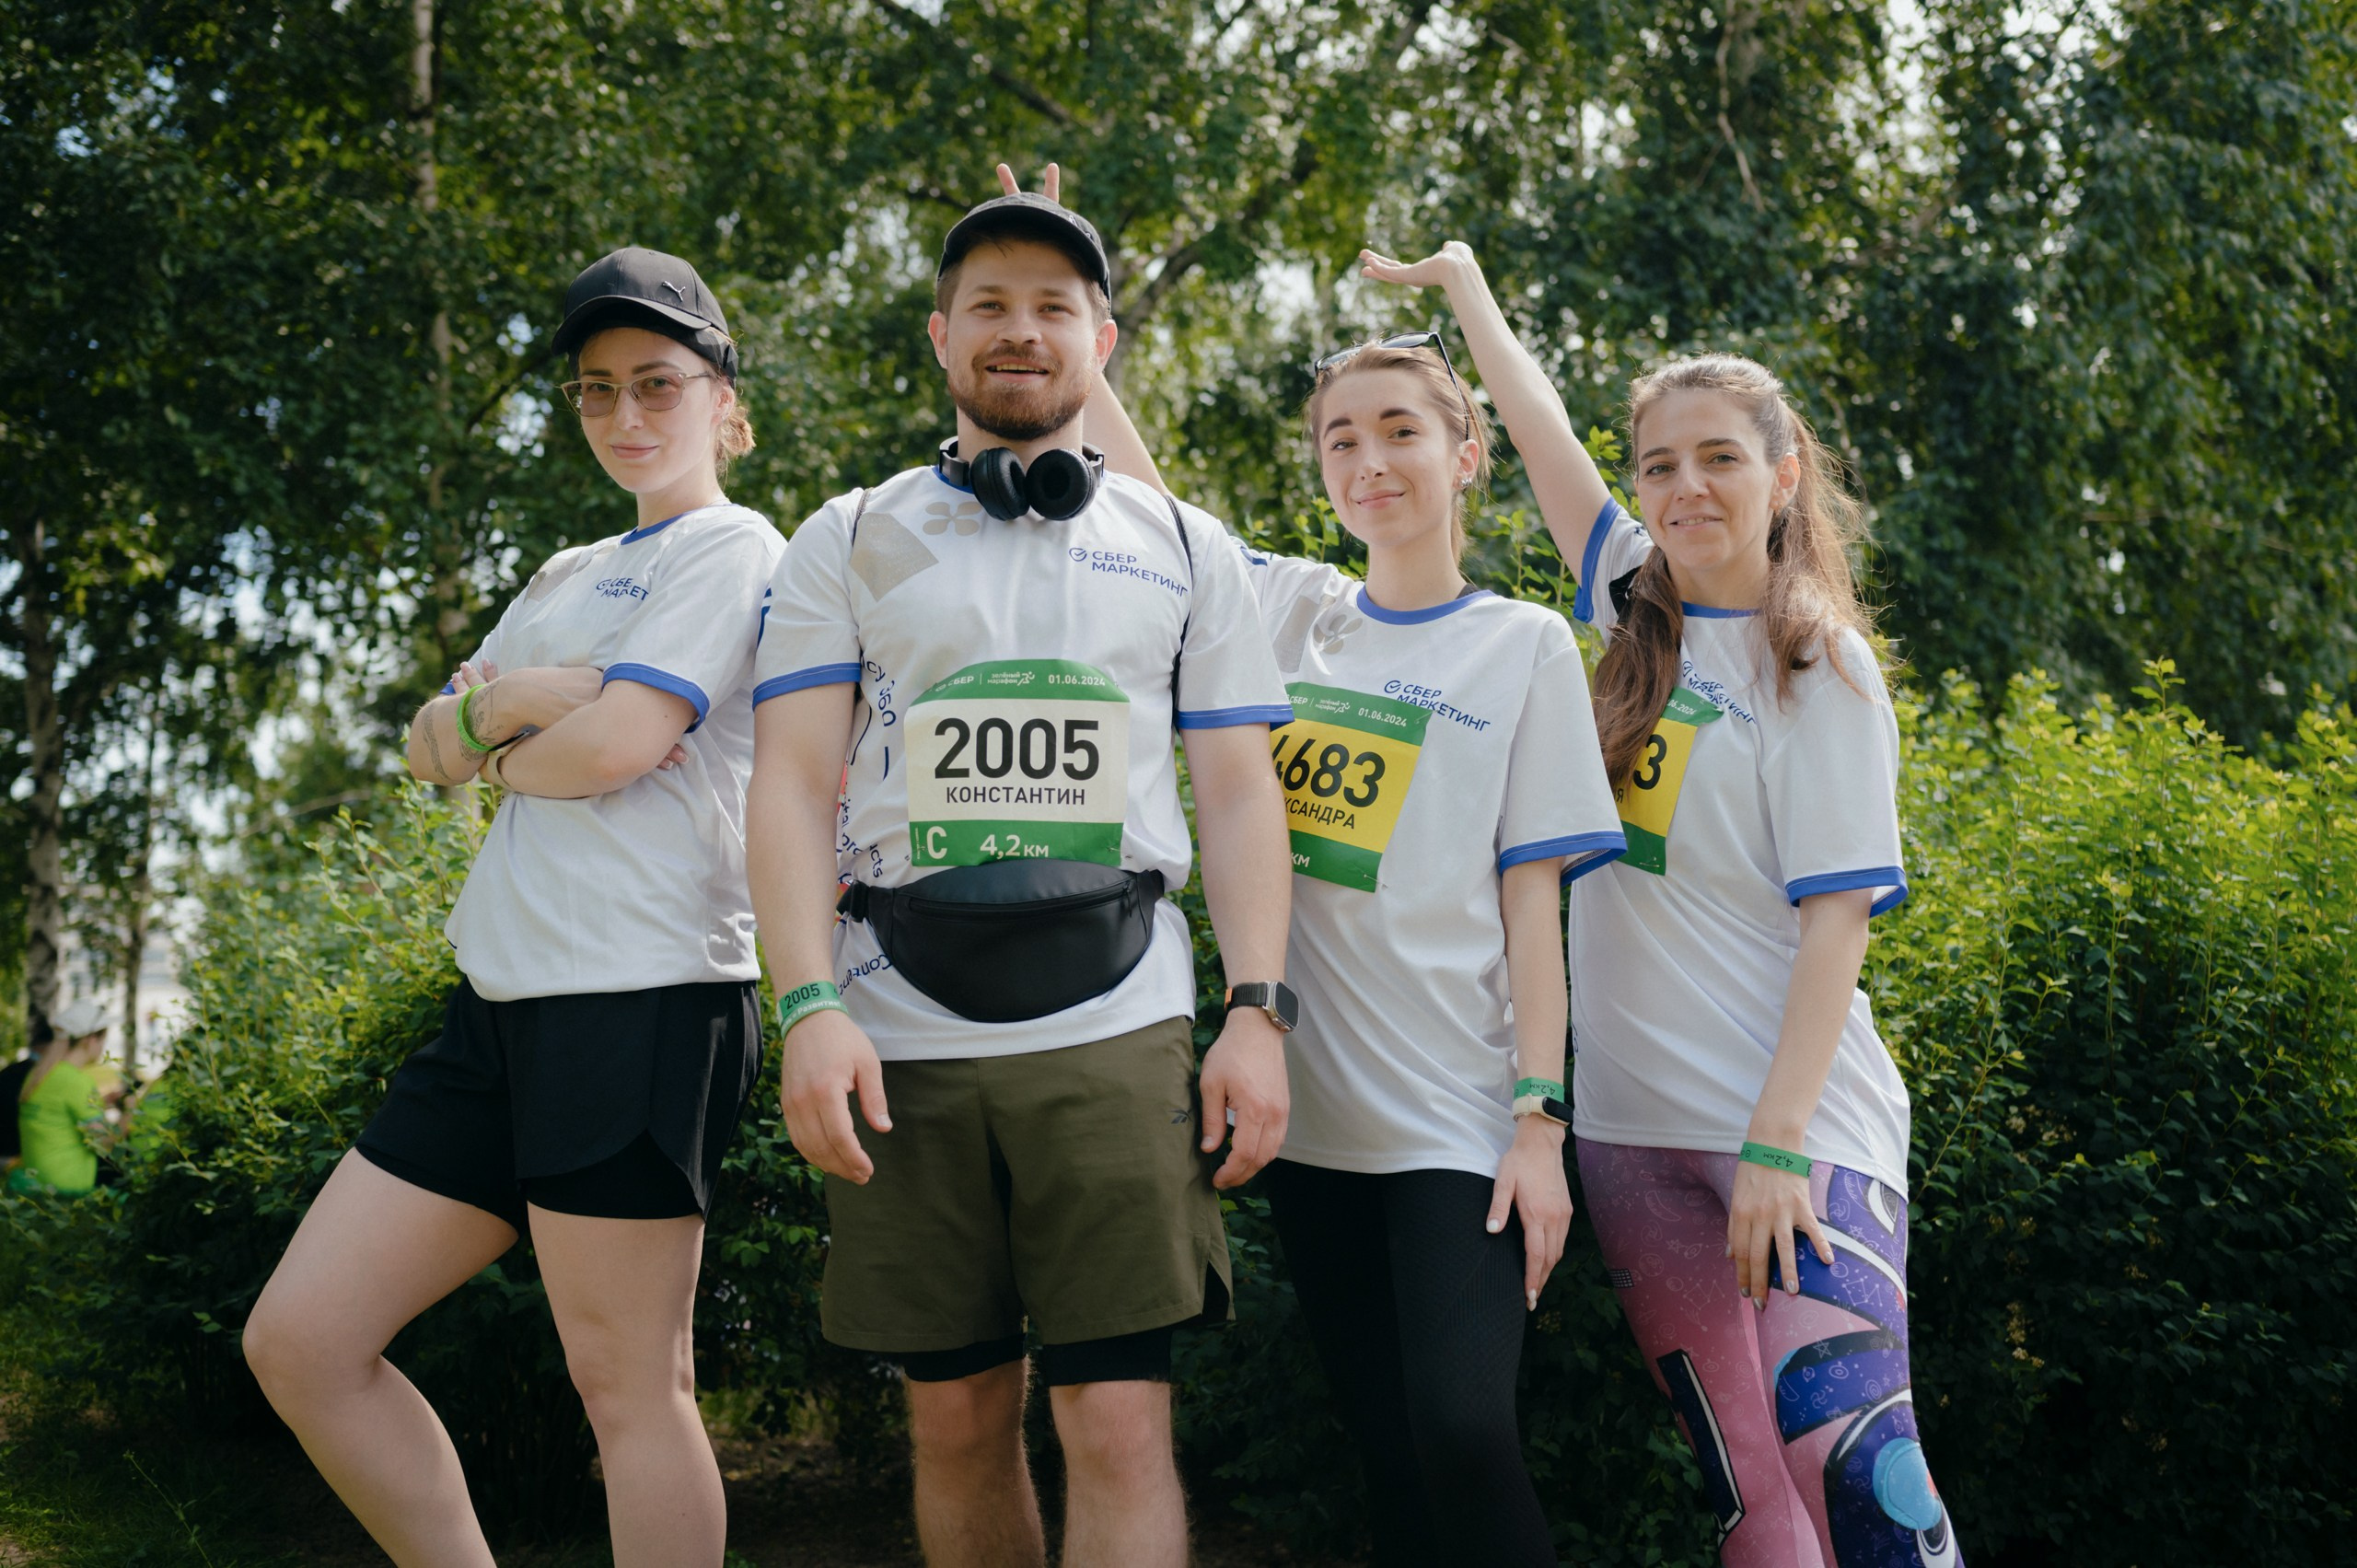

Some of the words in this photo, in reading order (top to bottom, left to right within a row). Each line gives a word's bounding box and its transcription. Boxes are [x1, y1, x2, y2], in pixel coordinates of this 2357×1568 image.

[1092, 551, 1137, 564] СБЕР
[1091, 561, 1189, 598] МАРКЕТИНГ
[1048, 674, 1106, 686] 01.06.2024
[1403, 684, 1442, 699] СБЕР
[1289, 695, 1308, 704] СБЕР
[1358, 707, 1407, 727] 01.06.2024
[1397, 694, 1491, 732] МАРКЕТИНГ
[935, 717, 1099, 781] 2005
[946, 786, 1086, 806] КОНСТАНТИН
[1283, 796, 1355, 830] КСАНДРА
[839, 954, 893, 996] Content
[784, 982, 820, 1010] 2005
